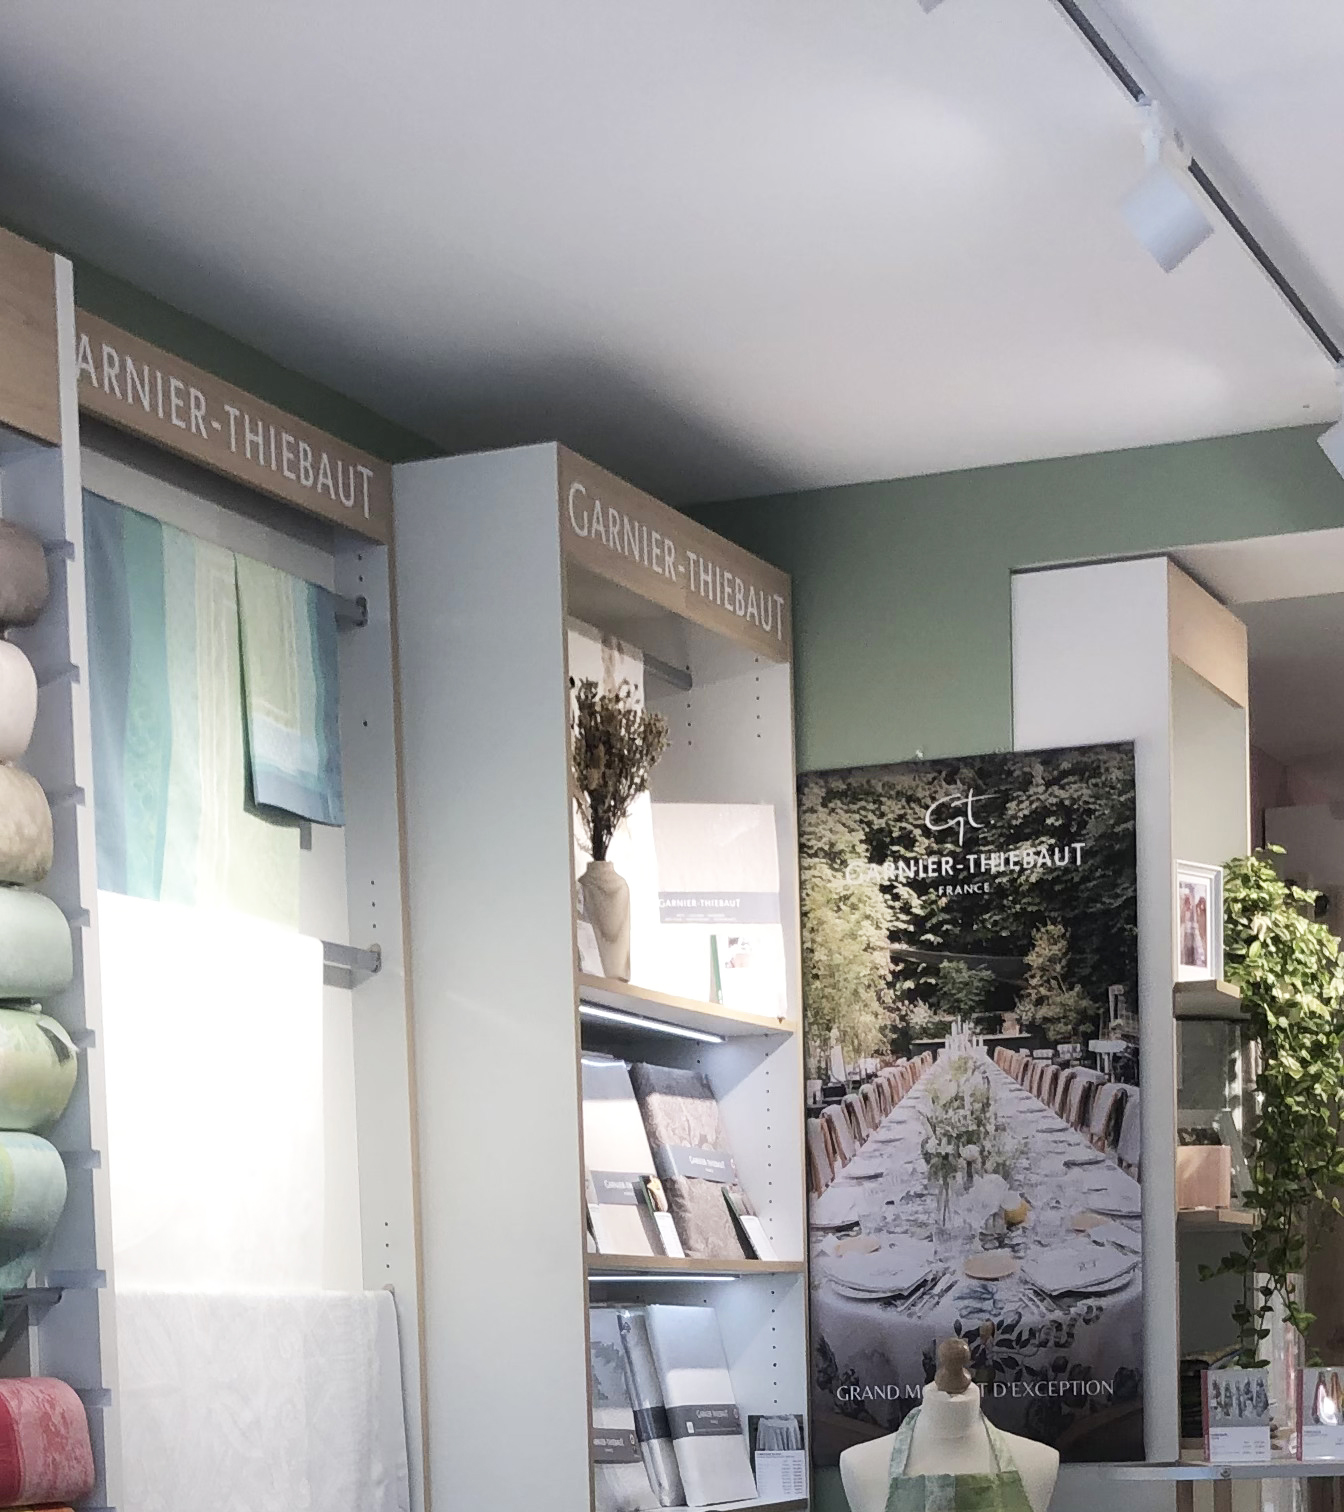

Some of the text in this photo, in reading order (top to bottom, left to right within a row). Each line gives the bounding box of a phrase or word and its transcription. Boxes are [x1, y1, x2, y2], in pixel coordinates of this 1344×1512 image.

[76, 333, 374, 520] ARNIER-THIEBAUT
[568, 481, 785, 641] GARNIER-THIEBAUT
[845, 842, 1087, 885] GARNIER-THIEBAUT
[938, 882, 991, 897] FRANCE
[836, 1384, 900, 1401] GRAND
[993, 1379, 1115, 1398] D'EXCEPTION
